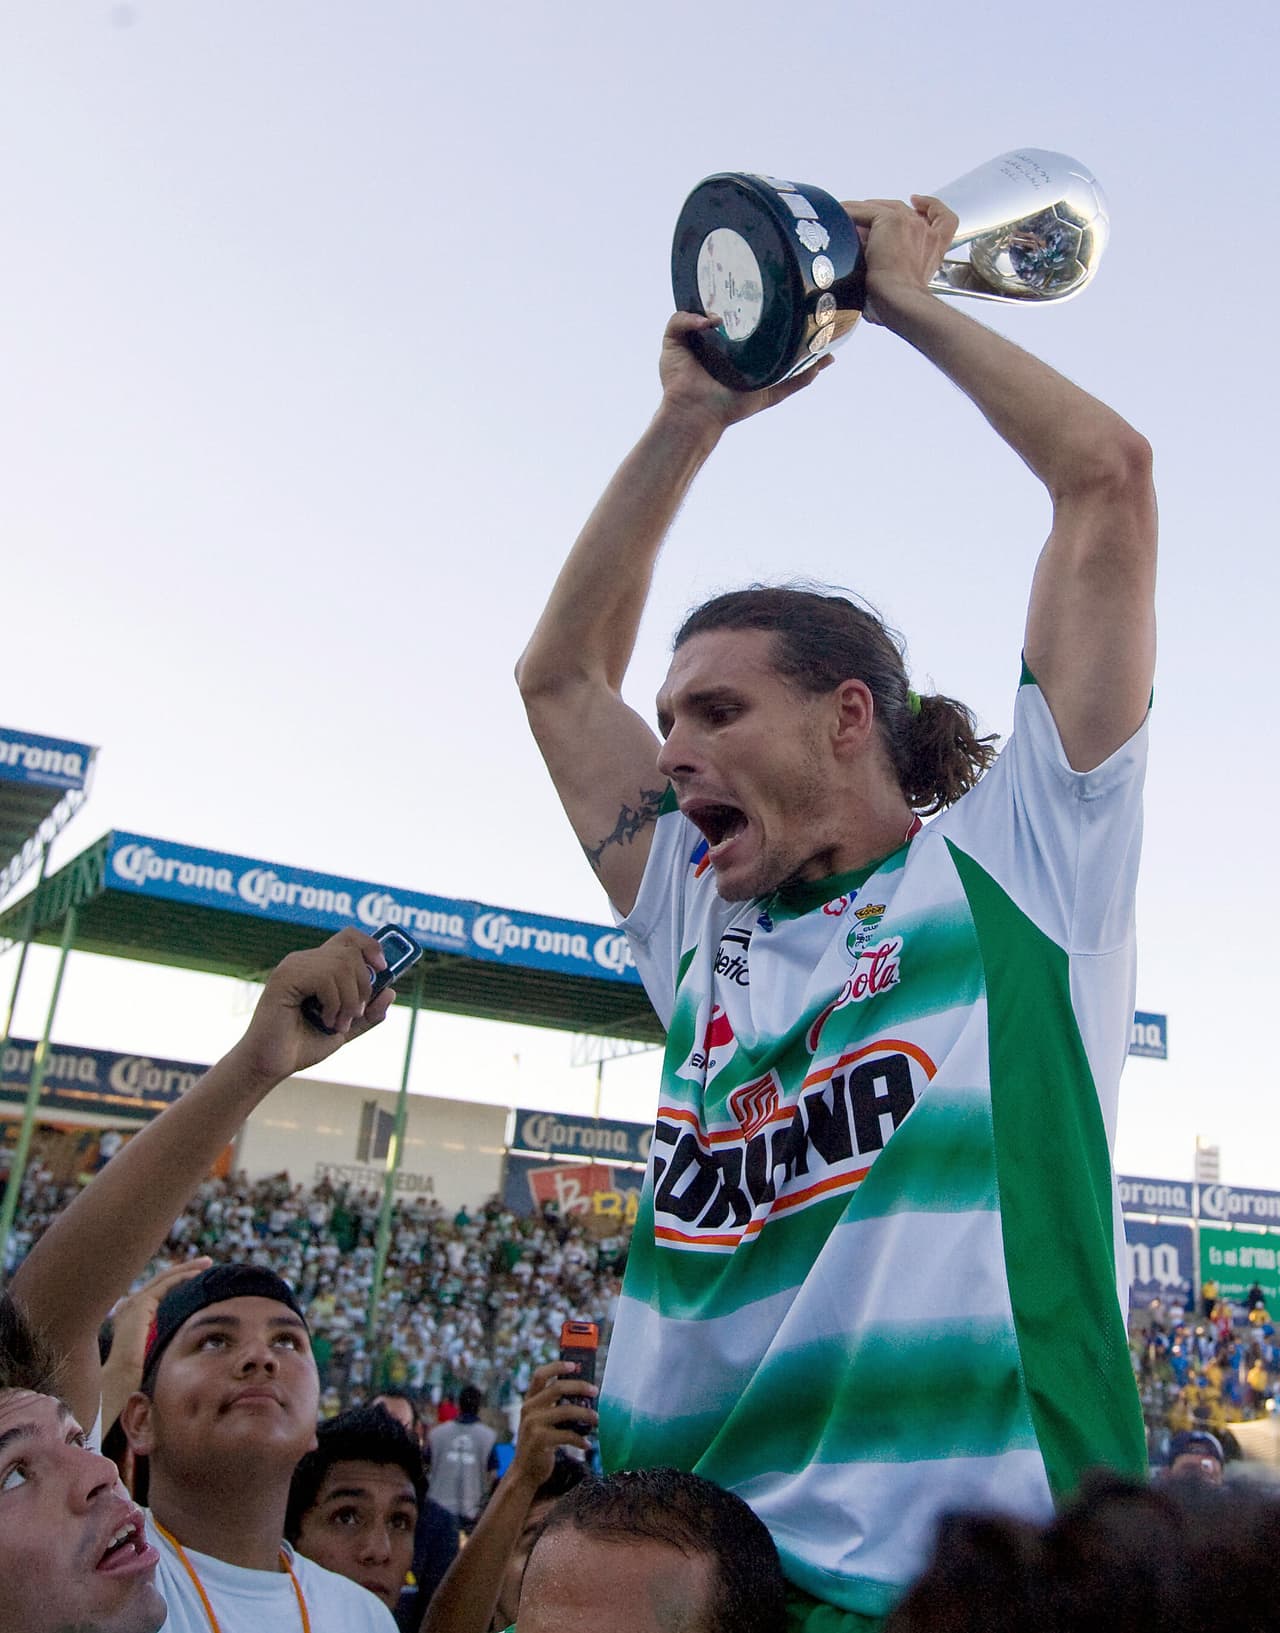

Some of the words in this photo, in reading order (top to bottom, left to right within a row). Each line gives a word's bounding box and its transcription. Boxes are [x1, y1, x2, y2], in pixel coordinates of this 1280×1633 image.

[112, 844, 234, 892] Corona
[238, 867, 352, 916] Corona
[357, 892, 465, 937] Corona
[473, 912, 589, 960] Corona
[3, 1047, 97, 1084] orona
[110, 1055, 200, 1097] Coro
[521, 1113, 629, 1153] Corona
[1118, 1181, 1187, 1208] orona
[1201, 1184, 1280, 1221] Coron
